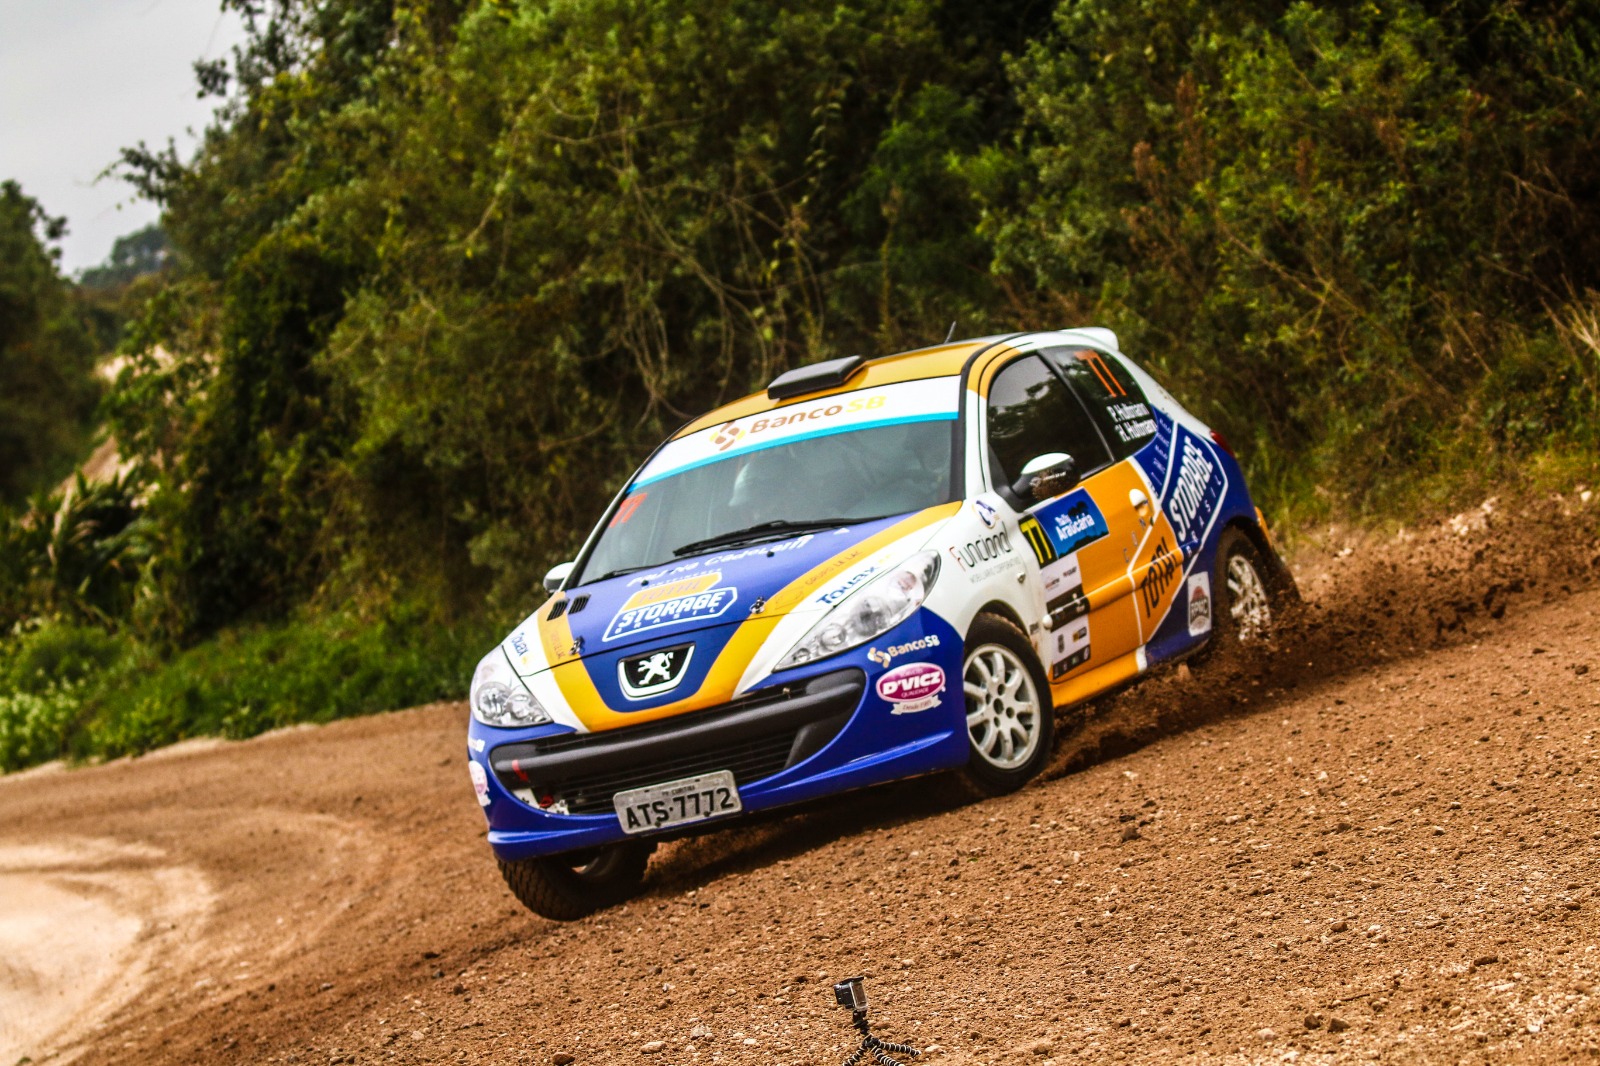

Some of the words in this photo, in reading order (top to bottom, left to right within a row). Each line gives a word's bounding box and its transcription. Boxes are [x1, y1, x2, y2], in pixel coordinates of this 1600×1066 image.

[1074, 350, 1127, 398] 77
[1170, 435, 1213, 542] STORAGE
[1020, 518, 1052, 564] 77
[619, 591, 727, 628] STORAGE
[888, 634, 940, 657] BancoSB
[882, 671, 941, 695] D'VICZ
